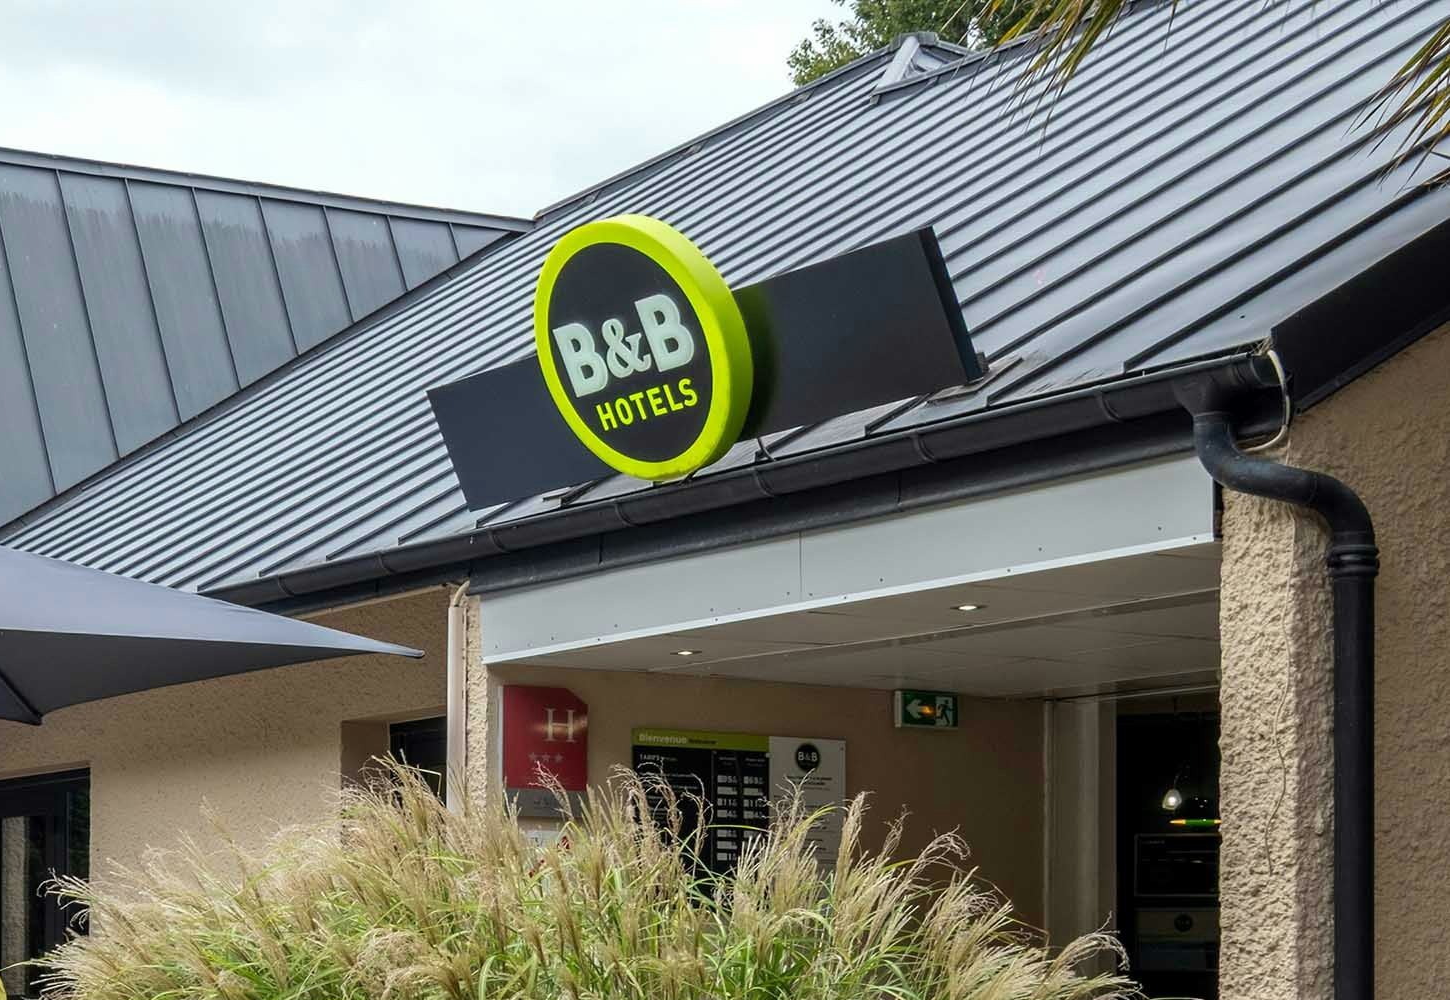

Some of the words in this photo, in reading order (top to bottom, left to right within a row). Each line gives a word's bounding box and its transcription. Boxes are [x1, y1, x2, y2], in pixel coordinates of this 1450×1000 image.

[553, 294, 695, 398] B&B
[596, 377, 698, 431] HOTELS
[544, 708, 576, 743] H
[637, 732, 688, 745] Bienvenue
